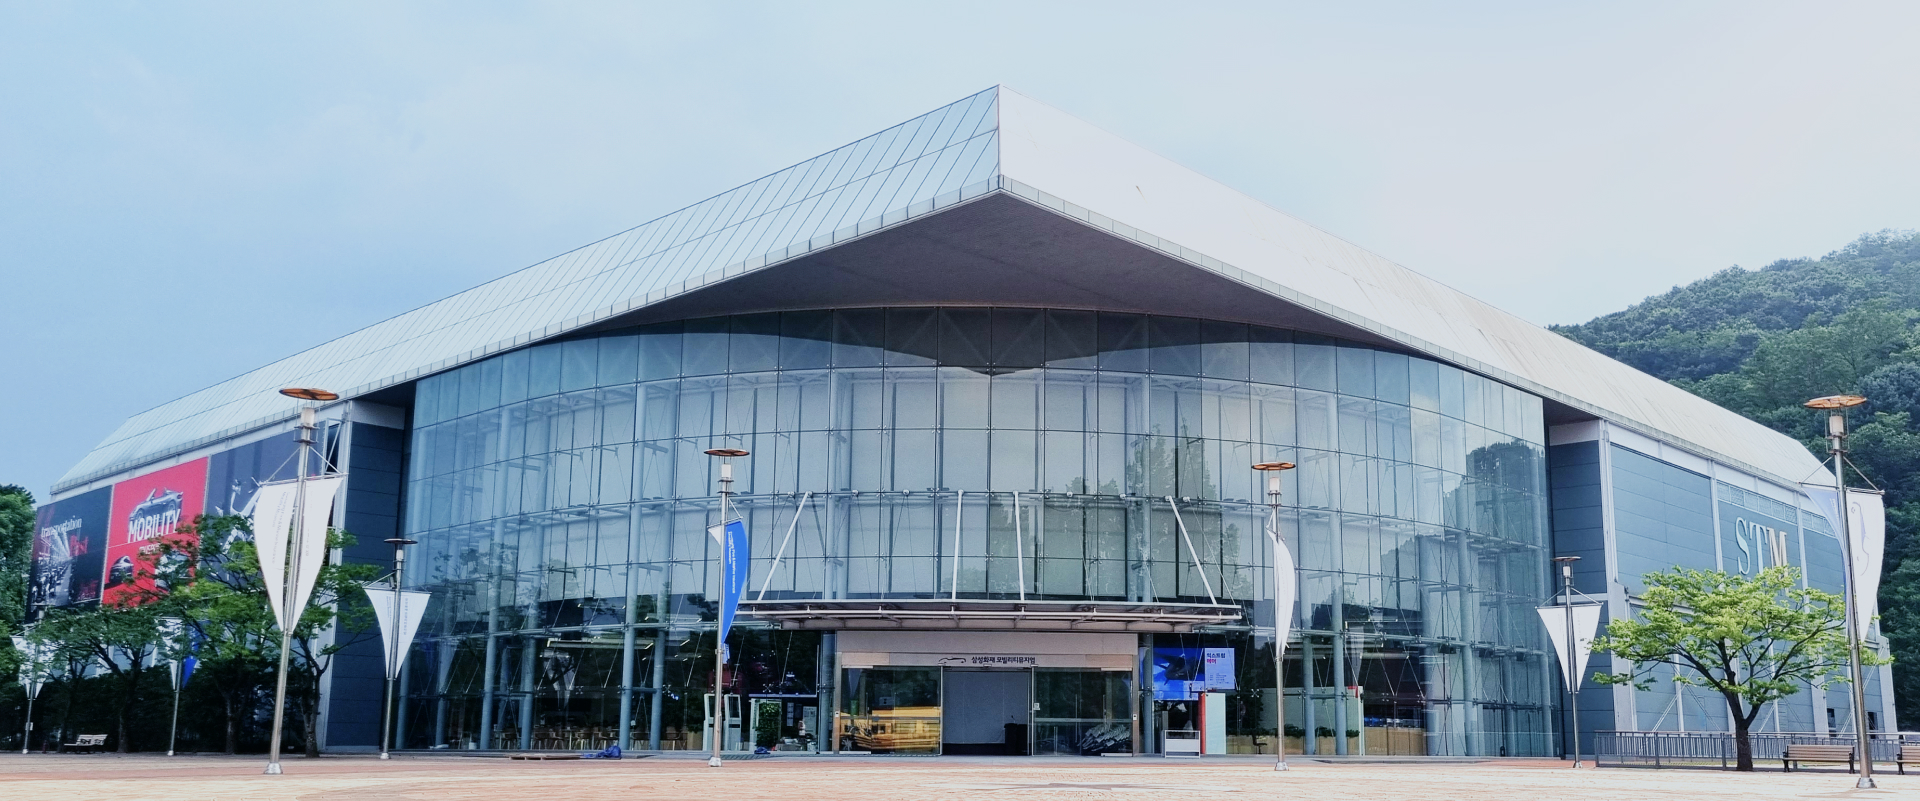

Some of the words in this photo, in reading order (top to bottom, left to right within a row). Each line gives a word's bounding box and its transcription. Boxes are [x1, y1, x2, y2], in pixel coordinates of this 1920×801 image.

[128, 508, 182, 543] MOBILITY
[1735, 516, 1788, 579] STM
[971, 656, 996, 664] 삼성화재
[996, 656, 1036, 664] 모빌리티뮤지엄
